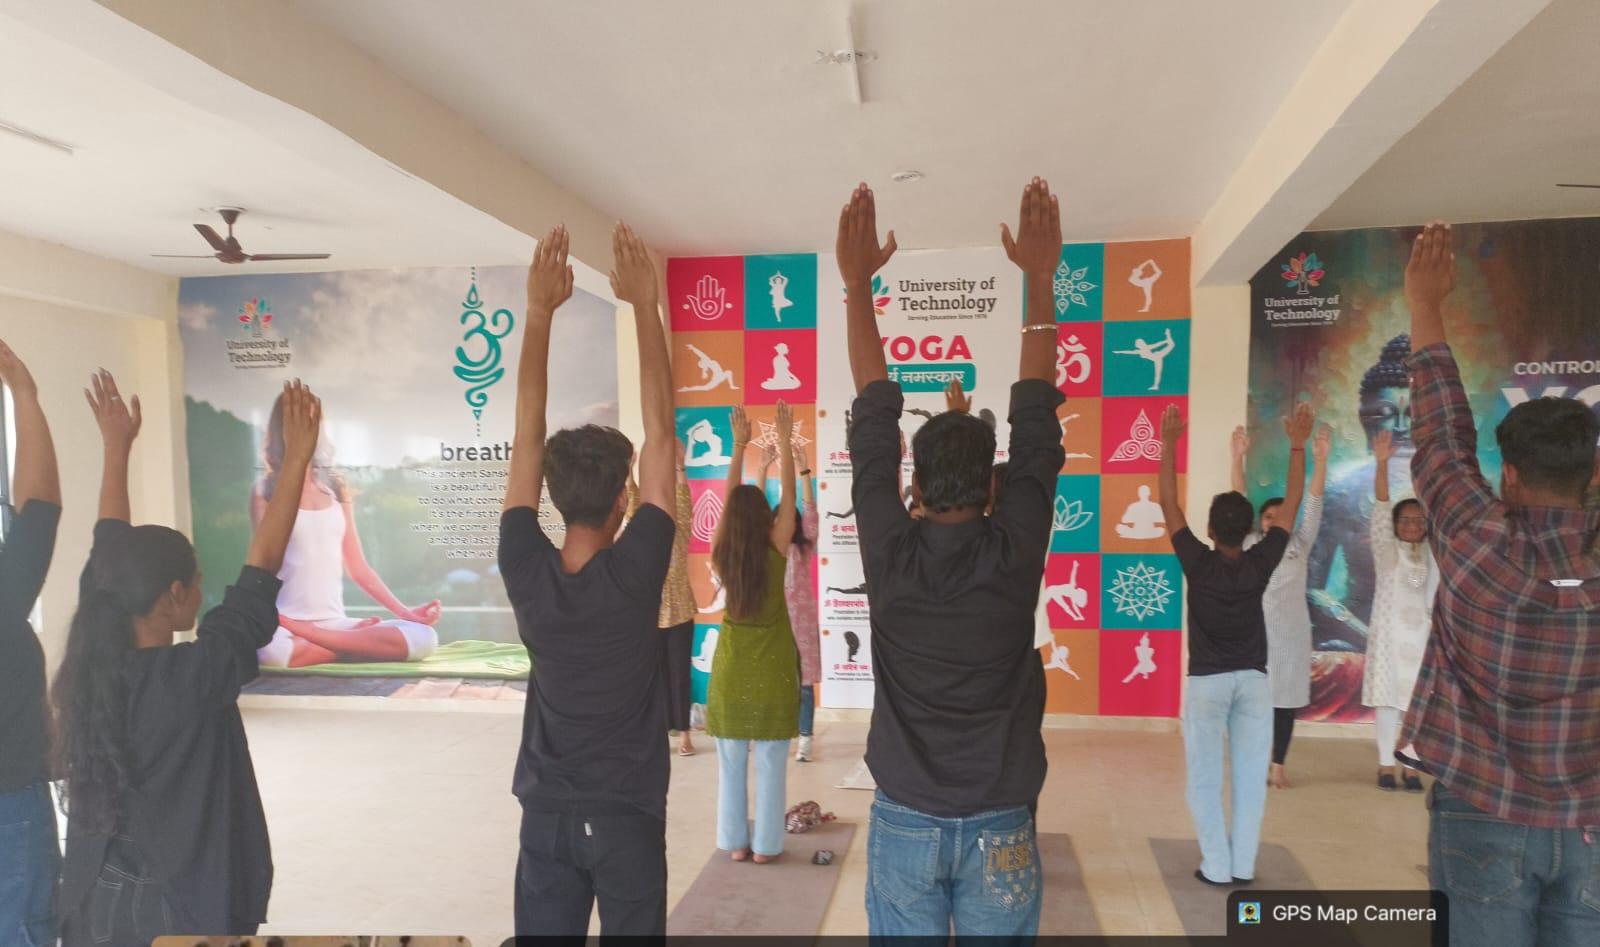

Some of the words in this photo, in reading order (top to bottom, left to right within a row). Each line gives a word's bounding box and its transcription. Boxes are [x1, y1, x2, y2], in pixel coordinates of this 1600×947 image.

[899, 278, 976, 294] University
[980, 276, 996, 291] of
[899, 296, 997, 312] Technology
[1264, 296, 1325, 307] University
[1327, 295, 1340, 305] of
[1264, 308, 1341, 321] Technology
[226, 339, 276, 350] University
[279, 337, 288, 348] of
[228, 351, 291, 364] Technology
[901, 371, 965, 384] नमस्कार
[441, 442, 513, 461] breath
[439, 470, 477, 478] ancient
[480, 469, 508, 478] Sansk
[450, 483, 495, 491] beautiful
[418, 497, 429, 505] to
[432, 497, 445, 505] do
[447, 497, 474, 505] what
[446, 510, 465, 518] the
[466, 510, 487, 518] first
[411, 523, 439, 531] when
[429, 536, 449, 544] and
[450, 536, 468, 544] the
[470, 536, 489, 544] last
